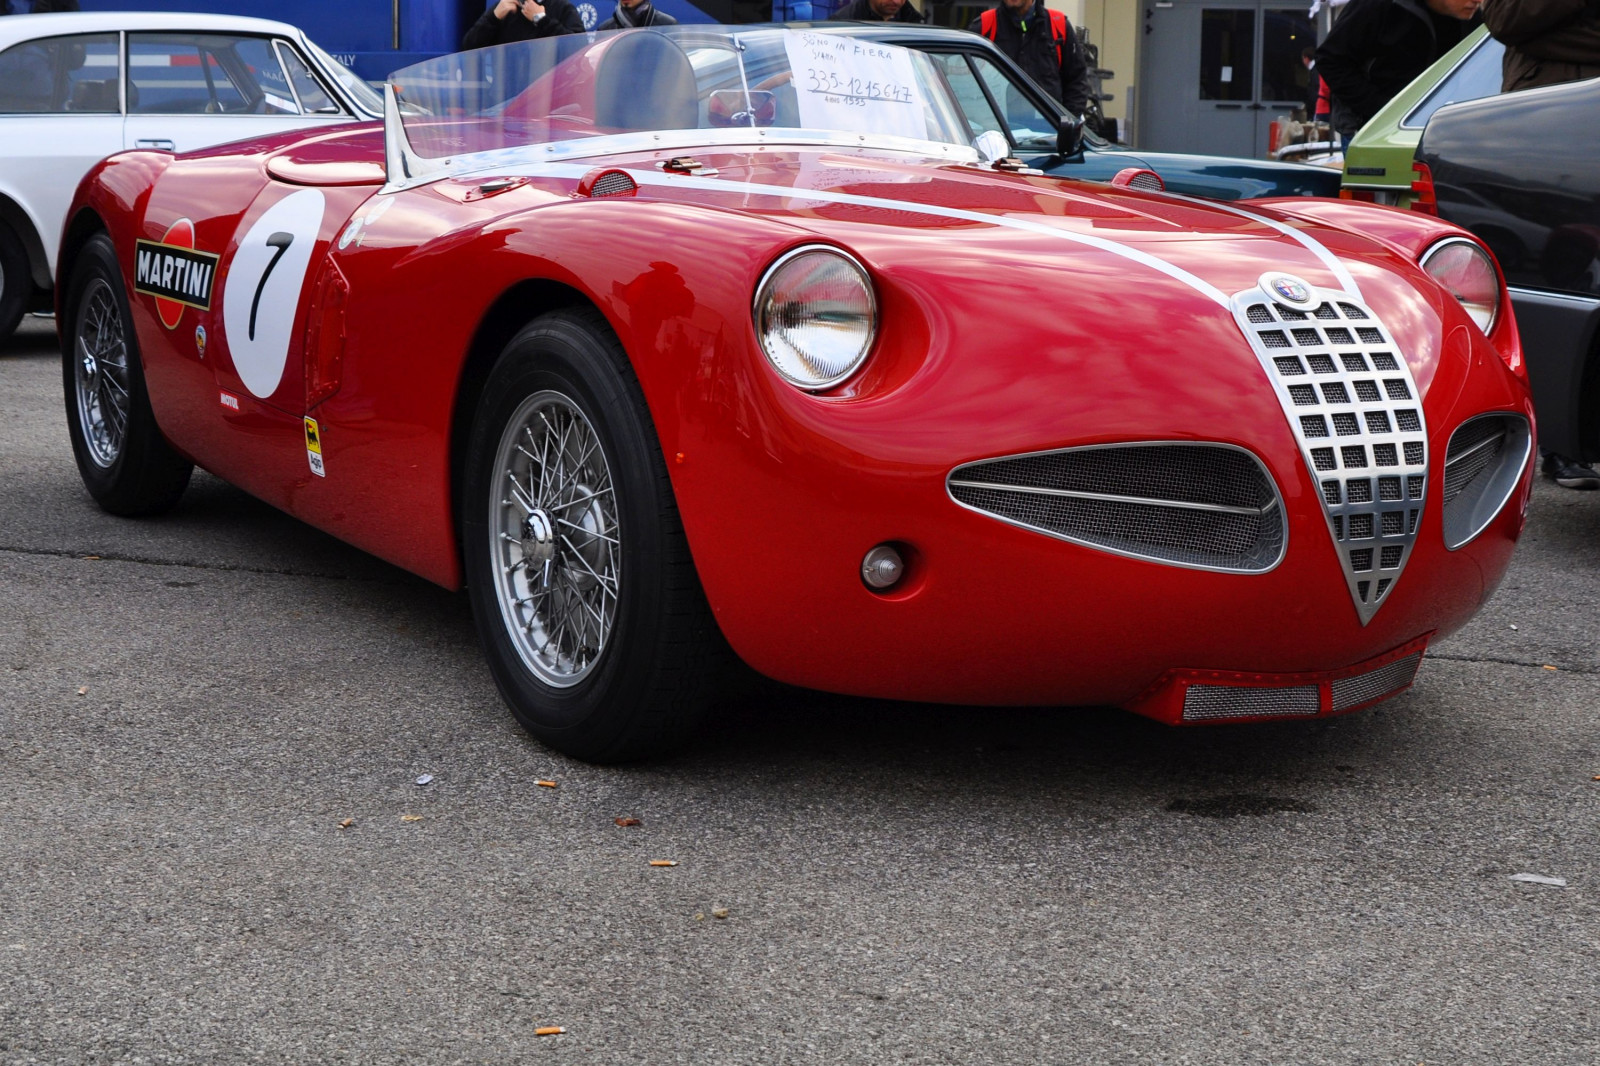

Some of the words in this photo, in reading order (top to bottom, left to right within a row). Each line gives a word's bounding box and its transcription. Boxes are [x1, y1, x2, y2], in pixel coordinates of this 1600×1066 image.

[835, 42, 846, 52] IN
[137, 250, 212, 299] MARTINI
[248, 231, 295, 342] 7
